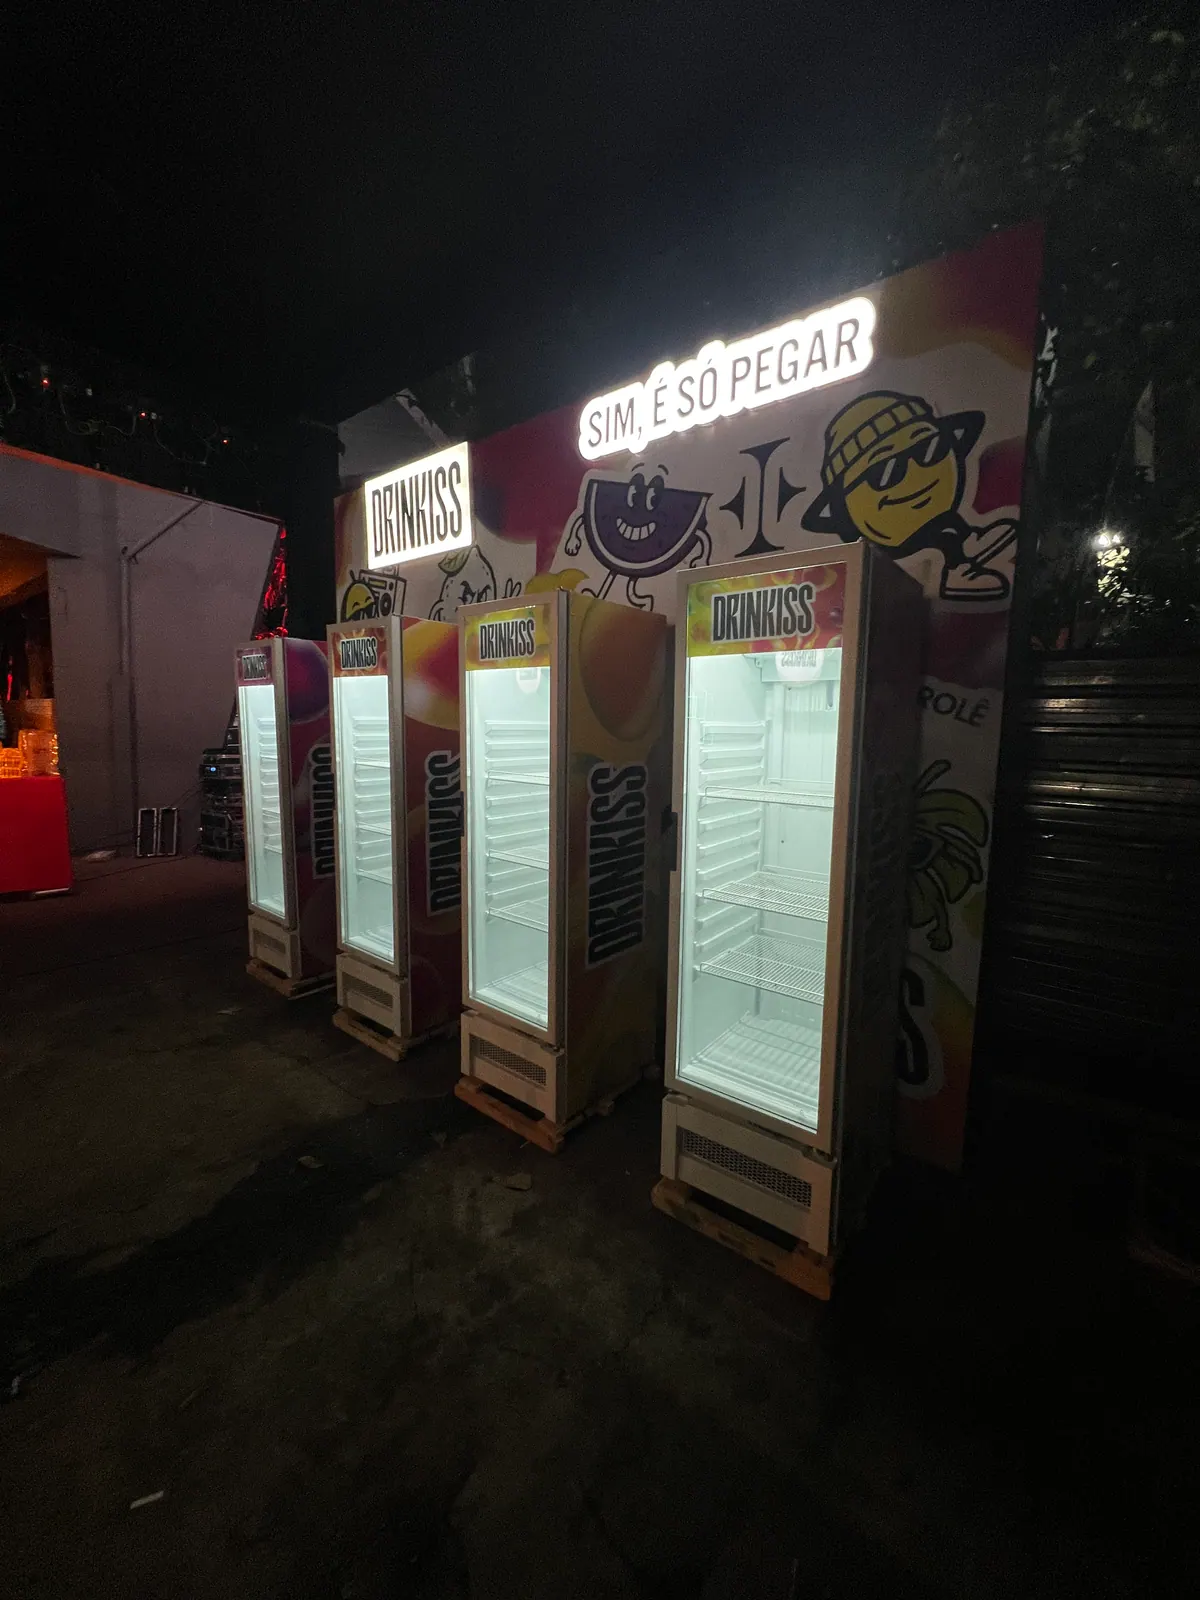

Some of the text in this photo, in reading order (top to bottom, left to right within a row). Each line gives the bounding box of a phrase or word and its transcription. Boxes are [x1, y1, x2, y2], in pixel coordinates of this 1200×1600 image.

[588, 318, 860, 448] SIM, É SÓ PEGAR
[372, 461, 462, 557] DRINKISS
[480, 619, 534, 659] DRINKISS
[713, 584, 813, 641] DRINKISS
[341, 638, 376, 668] DRINKISS
[588, 765, 646, 964] DRINKISS
